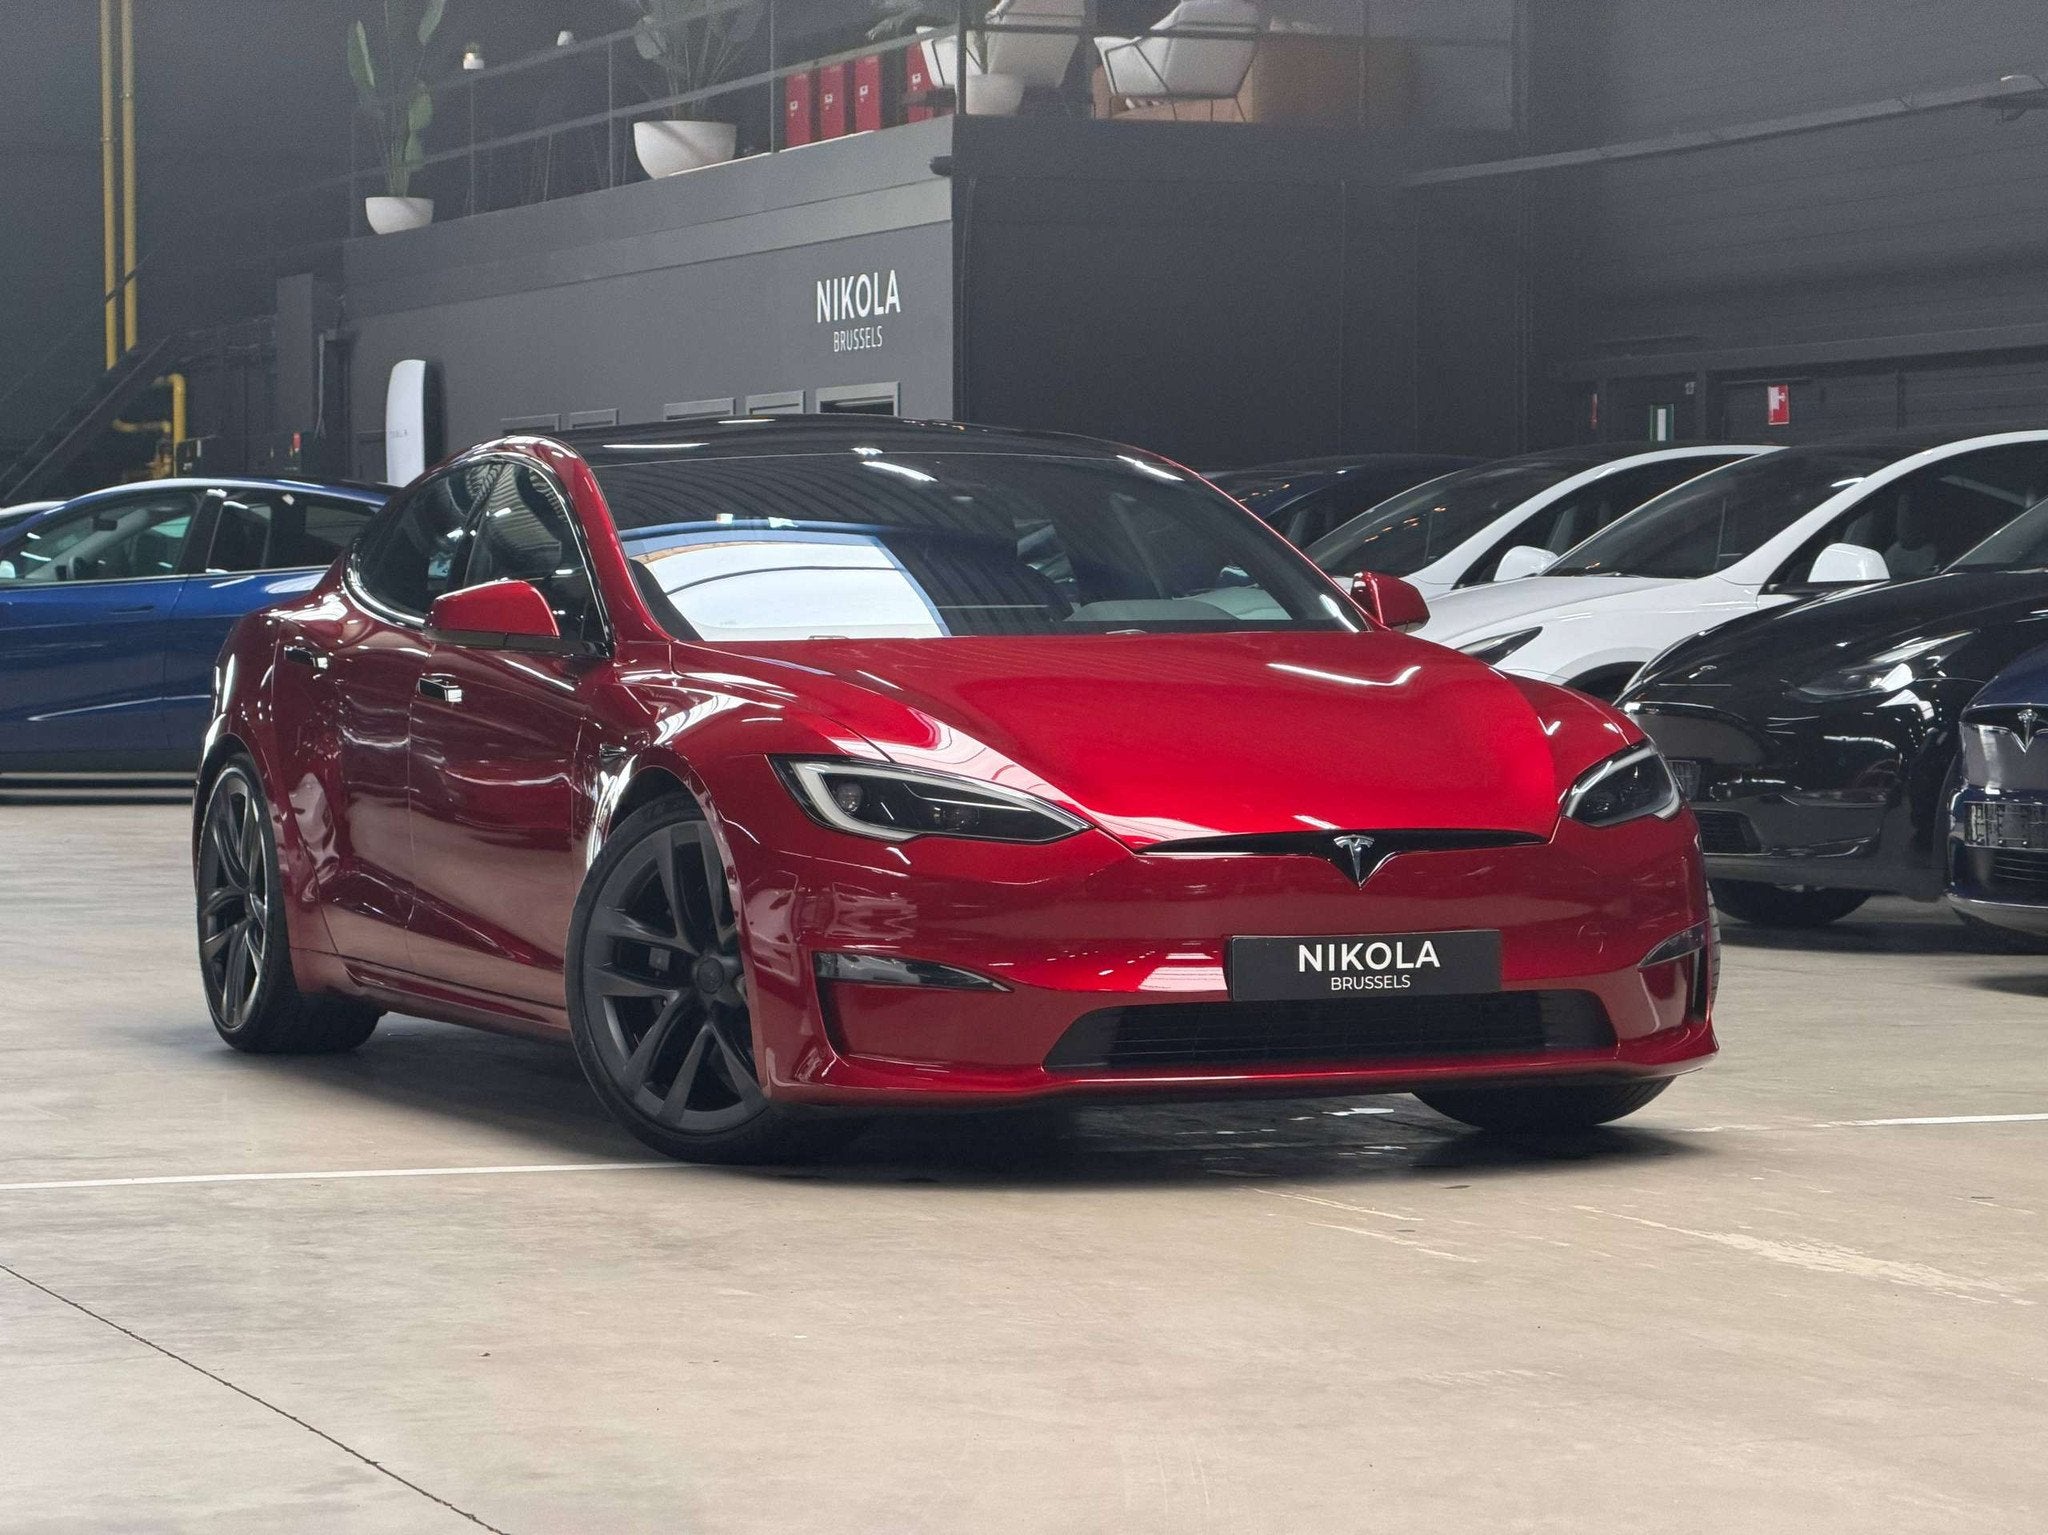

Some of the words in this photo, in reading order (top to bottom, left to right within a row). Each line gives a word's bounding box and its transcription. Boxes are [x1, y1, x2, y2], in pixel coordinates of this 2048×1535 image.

[817, 270, 901, 323] NIKOLA
[833, 325, 883, 352] BRUSSELS
[1298, 940, 1441, 972] NIKOLA
[1331, 974, 1411, 991] BRUSSELS
